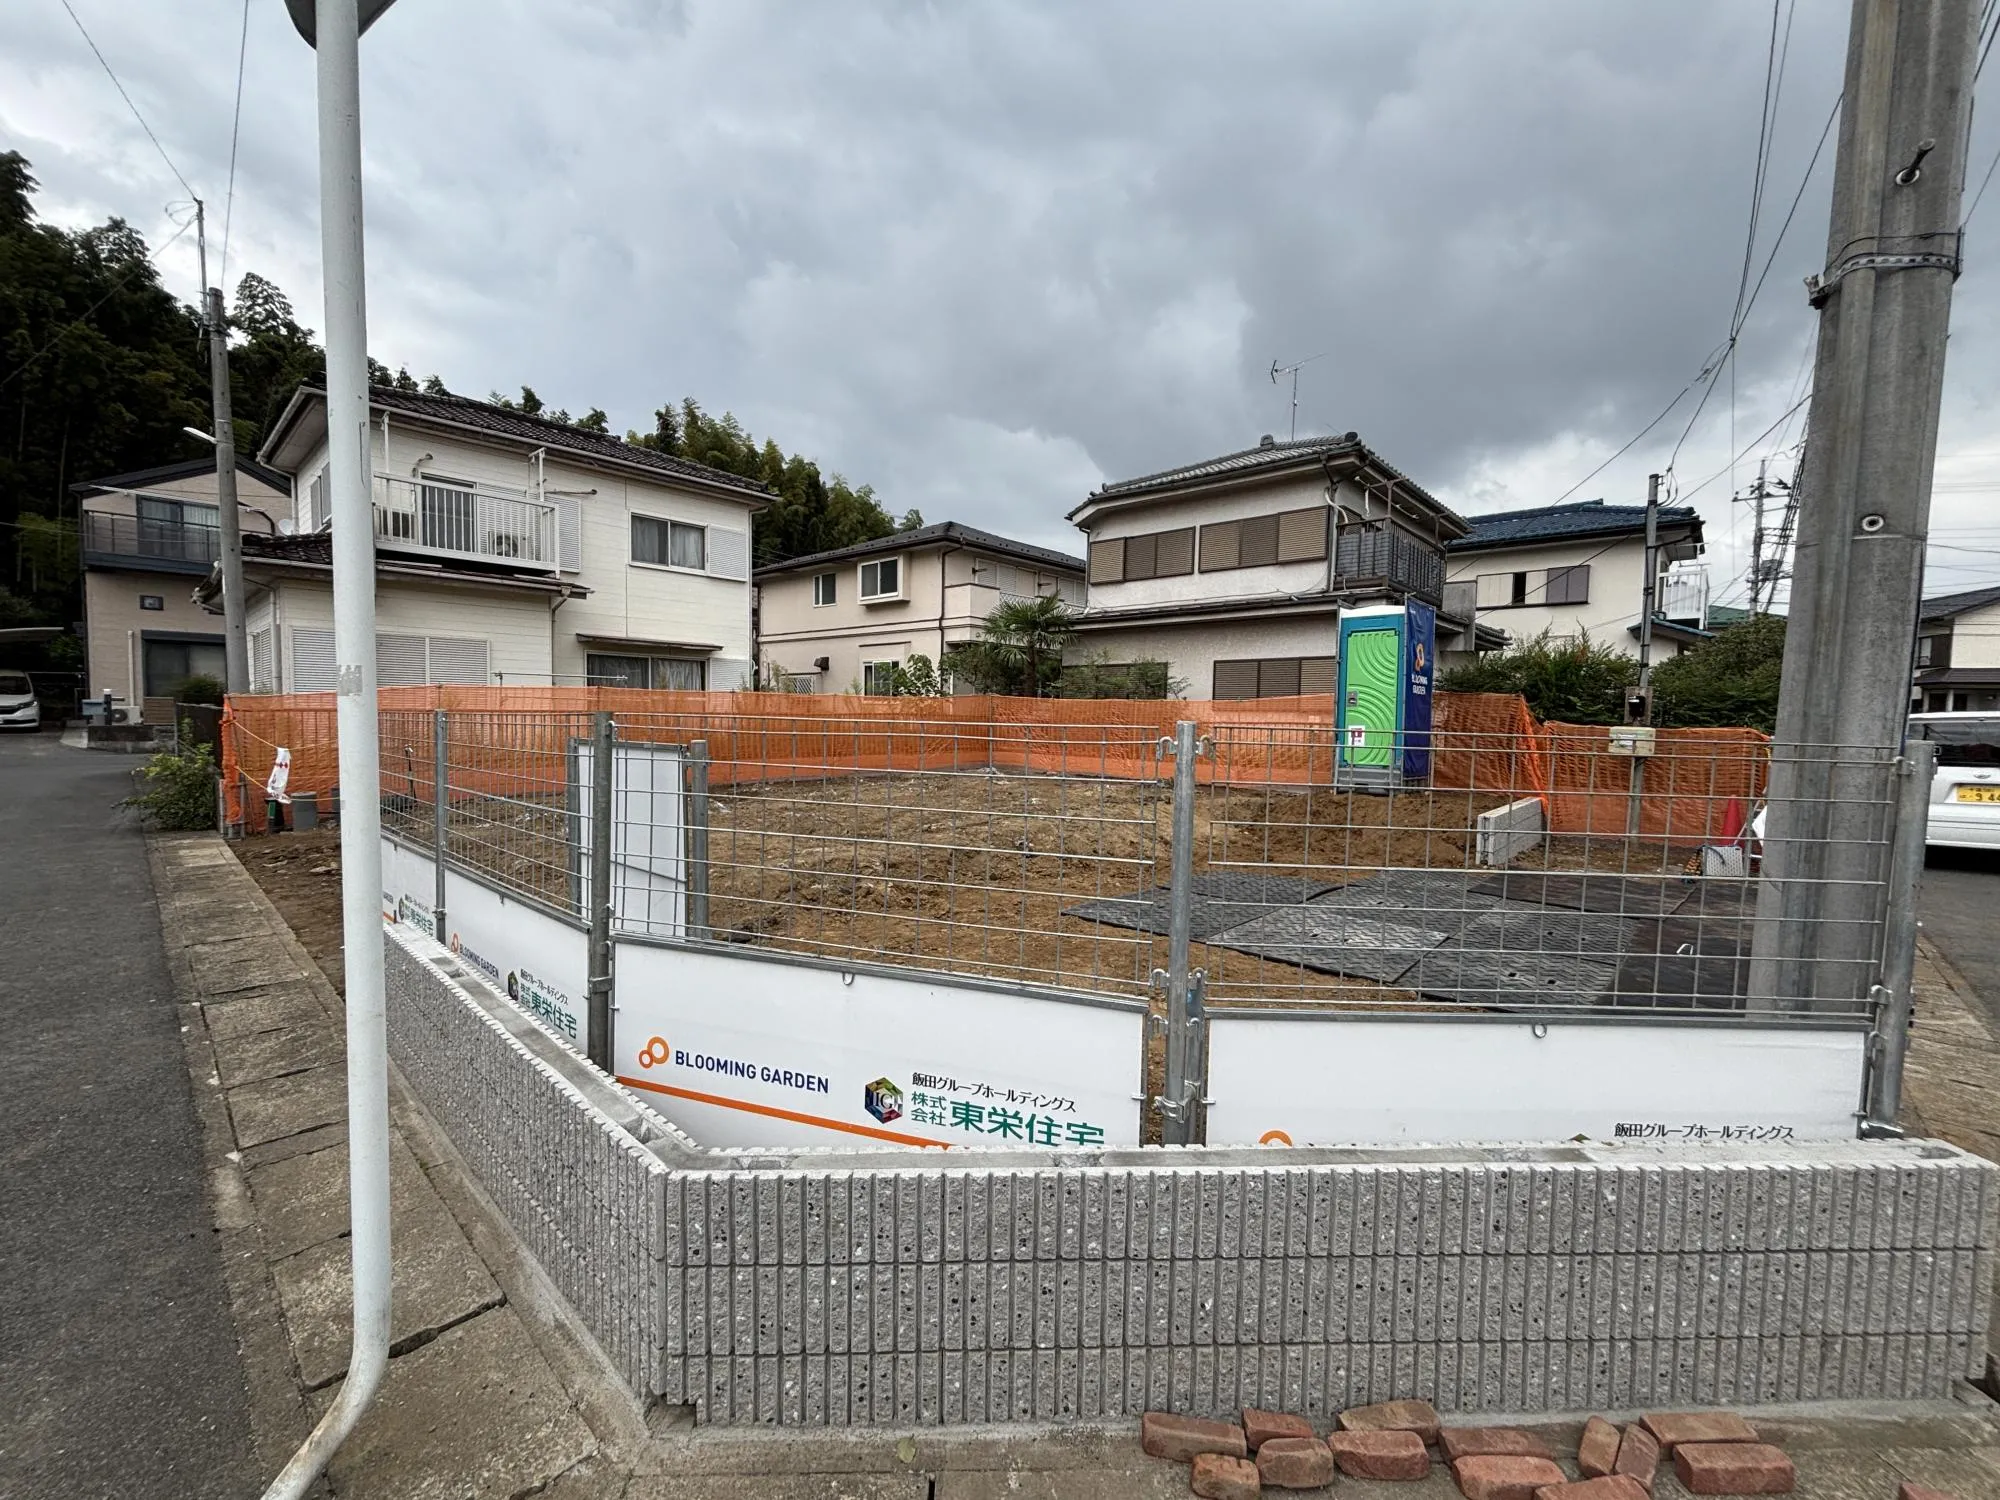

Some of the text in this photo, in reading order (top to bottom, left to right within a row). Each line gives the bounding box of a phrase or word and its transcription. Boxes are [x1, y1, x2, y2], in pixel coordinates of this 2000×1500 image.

[480, 957, 499, 979] GARDEN
[531, 990, 577, 1040] 東栄住宅
[675, 1050, 829, 1094] BLOOMING GARDEN
[911, 1091, 947, 1111] 株式
[912, 1072, 1077, 1113] 飯田グループホールディングス
[911, 1107, 947, 1127] 会社
[1614, 1122, 1795, 1141] 飯田グループホールディングス
